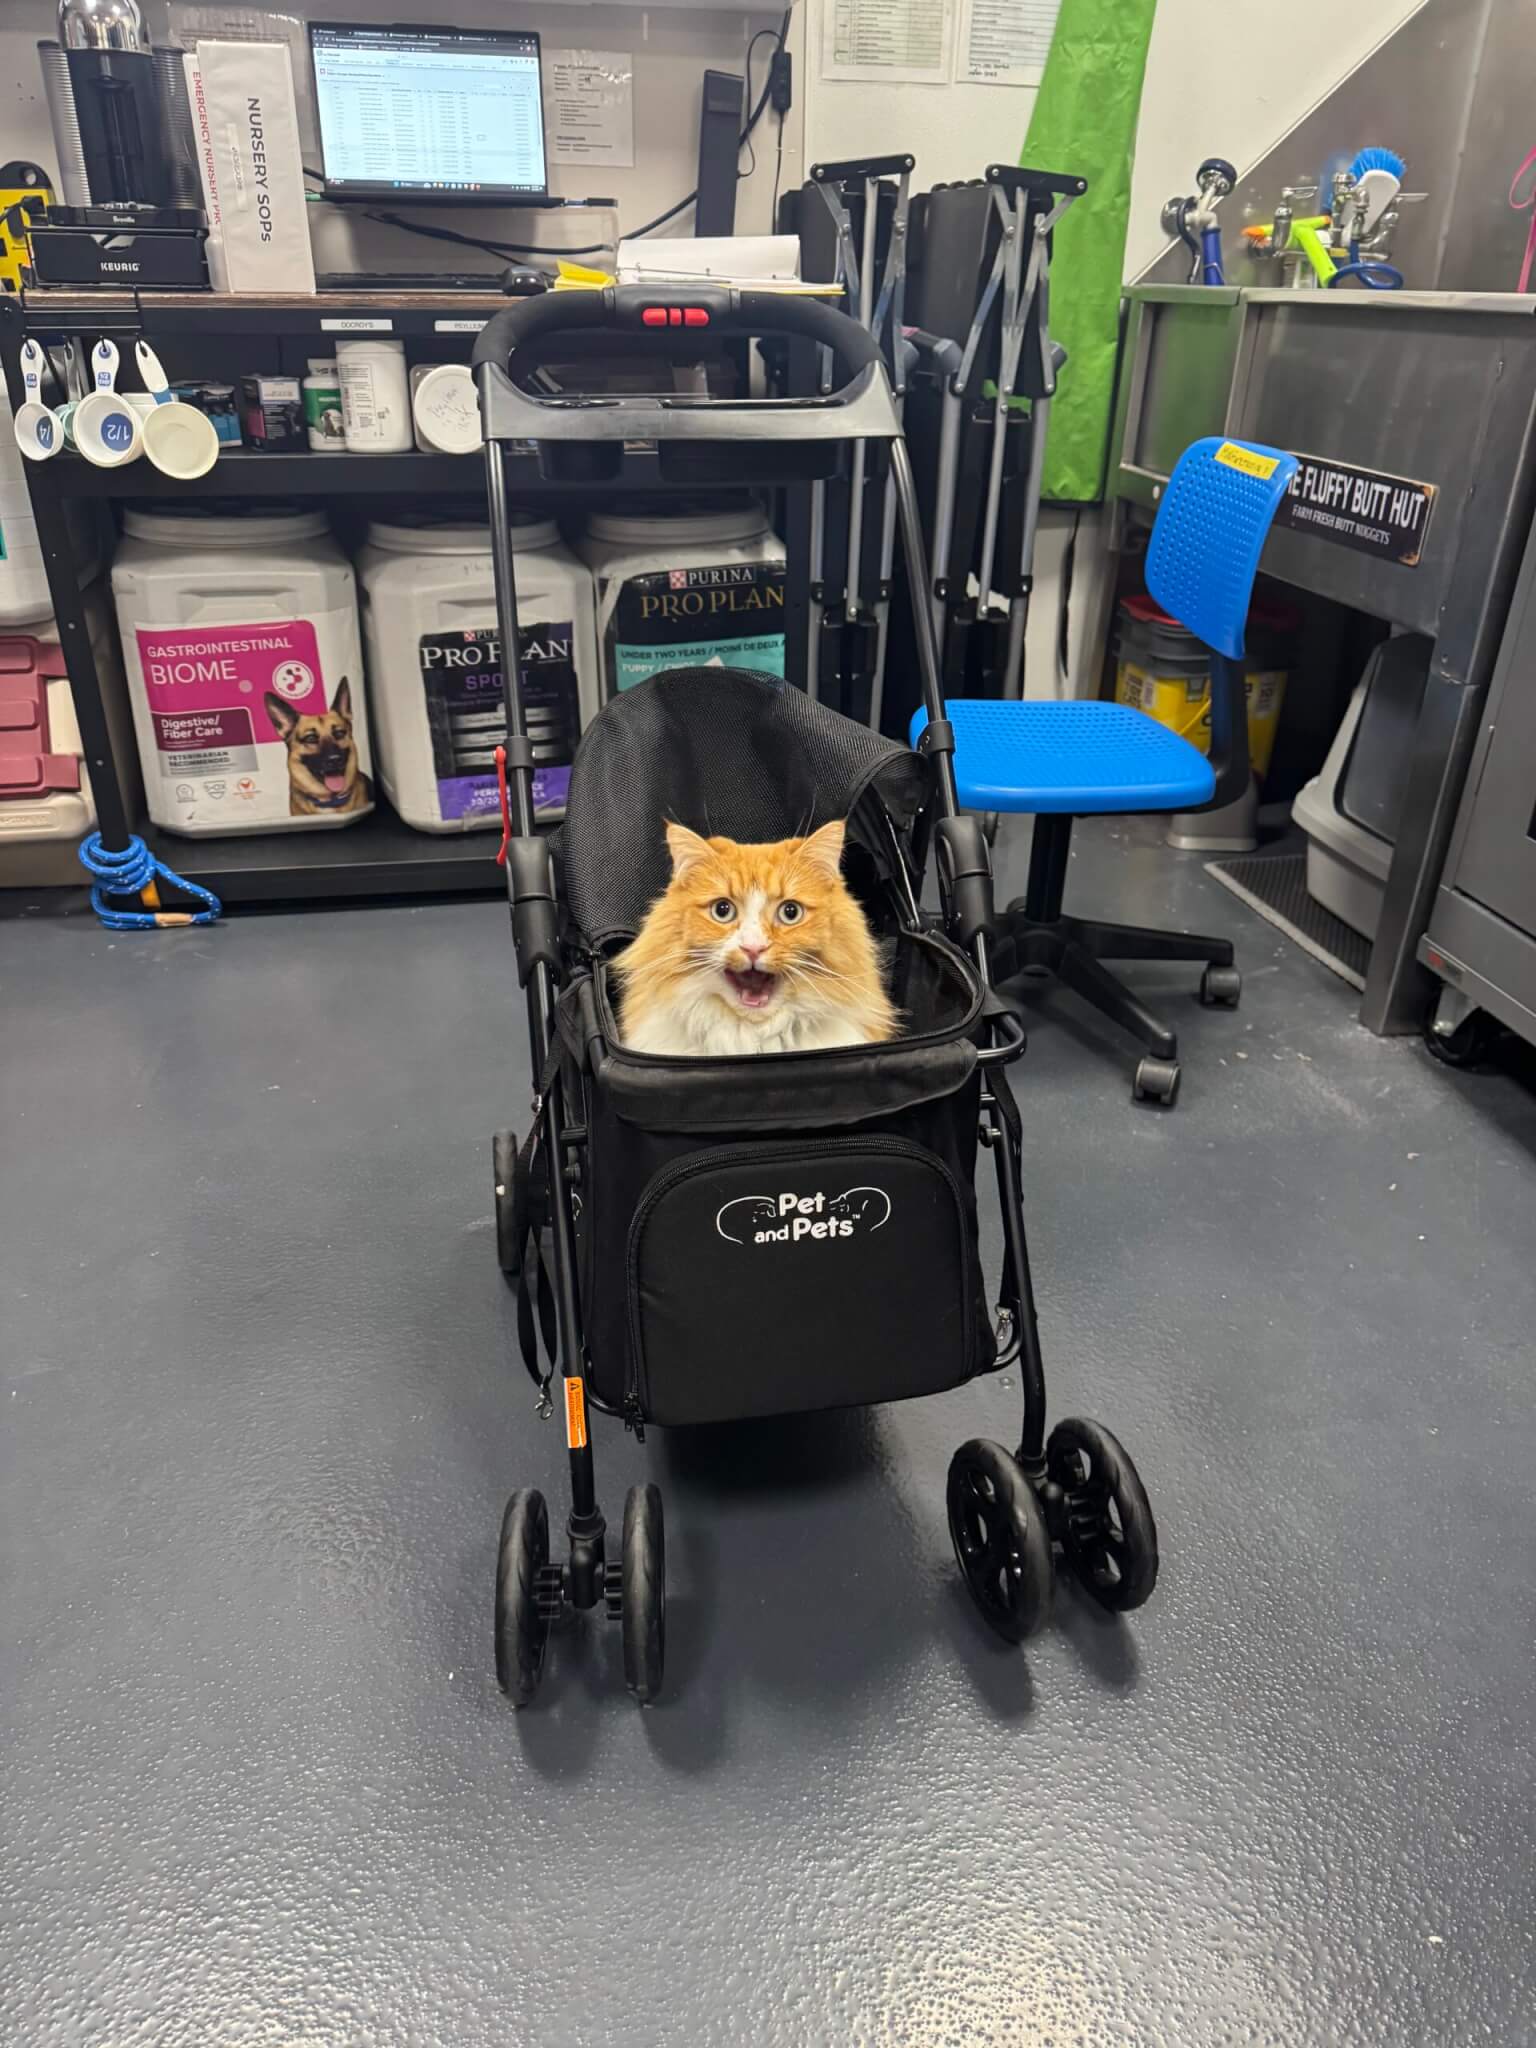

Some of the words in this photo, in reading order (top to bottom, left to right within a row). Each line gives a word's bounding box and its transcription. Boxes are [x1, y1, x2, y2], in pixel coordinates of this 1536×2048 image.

[192, 71, 213, 145] EMERGENCY
[204, 148, 221, 202] NURSERY
[247, 97, 270, 190] NURSERY
[257, 194, 274, 242] SOPs
[100, 262, 141, 272] KEURIG
[107, 424, 131, 441] 1/2
[1302, 465, 1353, 511] FLUFFY
[1351, 479, 1392, 521] BUTT
[1388, 488, 1426, 531] HUT
[1291, 504, 1313, 520] FARM
[1311, 510, 1335, 527] FRESH
[1333, 516, 1356, 534] BUTT
[1354, 523, 1391, 545] NUGGETS
[688, 567, 753, 585] PURINA
[640, 591, 704, 619] PRO
[710, 585, 785, 613] PLAN
[147, 636, 293, 658] GASTROINTESTINAL
[421, 646, 482, 669] PRO
[485, 639, 568, 662] PAN
[620, 649, 652, 660] UNDER
[655, 648, 676, 659] TWO
[678, 647, 707, 657] YEARS
[714, 644, 742, 655] MOINS
[743, 642, 755, 652] DE
[756, 641, 778, 651] DEUX
[151, 659, 238, 686] BIOME
[465, 670, 529, 691] SPOT
[622, 662, 655, 673] PUPPY
[161, 714, 220, 730] Digestive/
[163, 728, 193, 739] Fiber
[194, 727, 224, 738] Care
[778, 1191, 827, 1217] Pet
[754, 1224, 790, 1244] and
[792, 1216, 855, 1241] Pets
